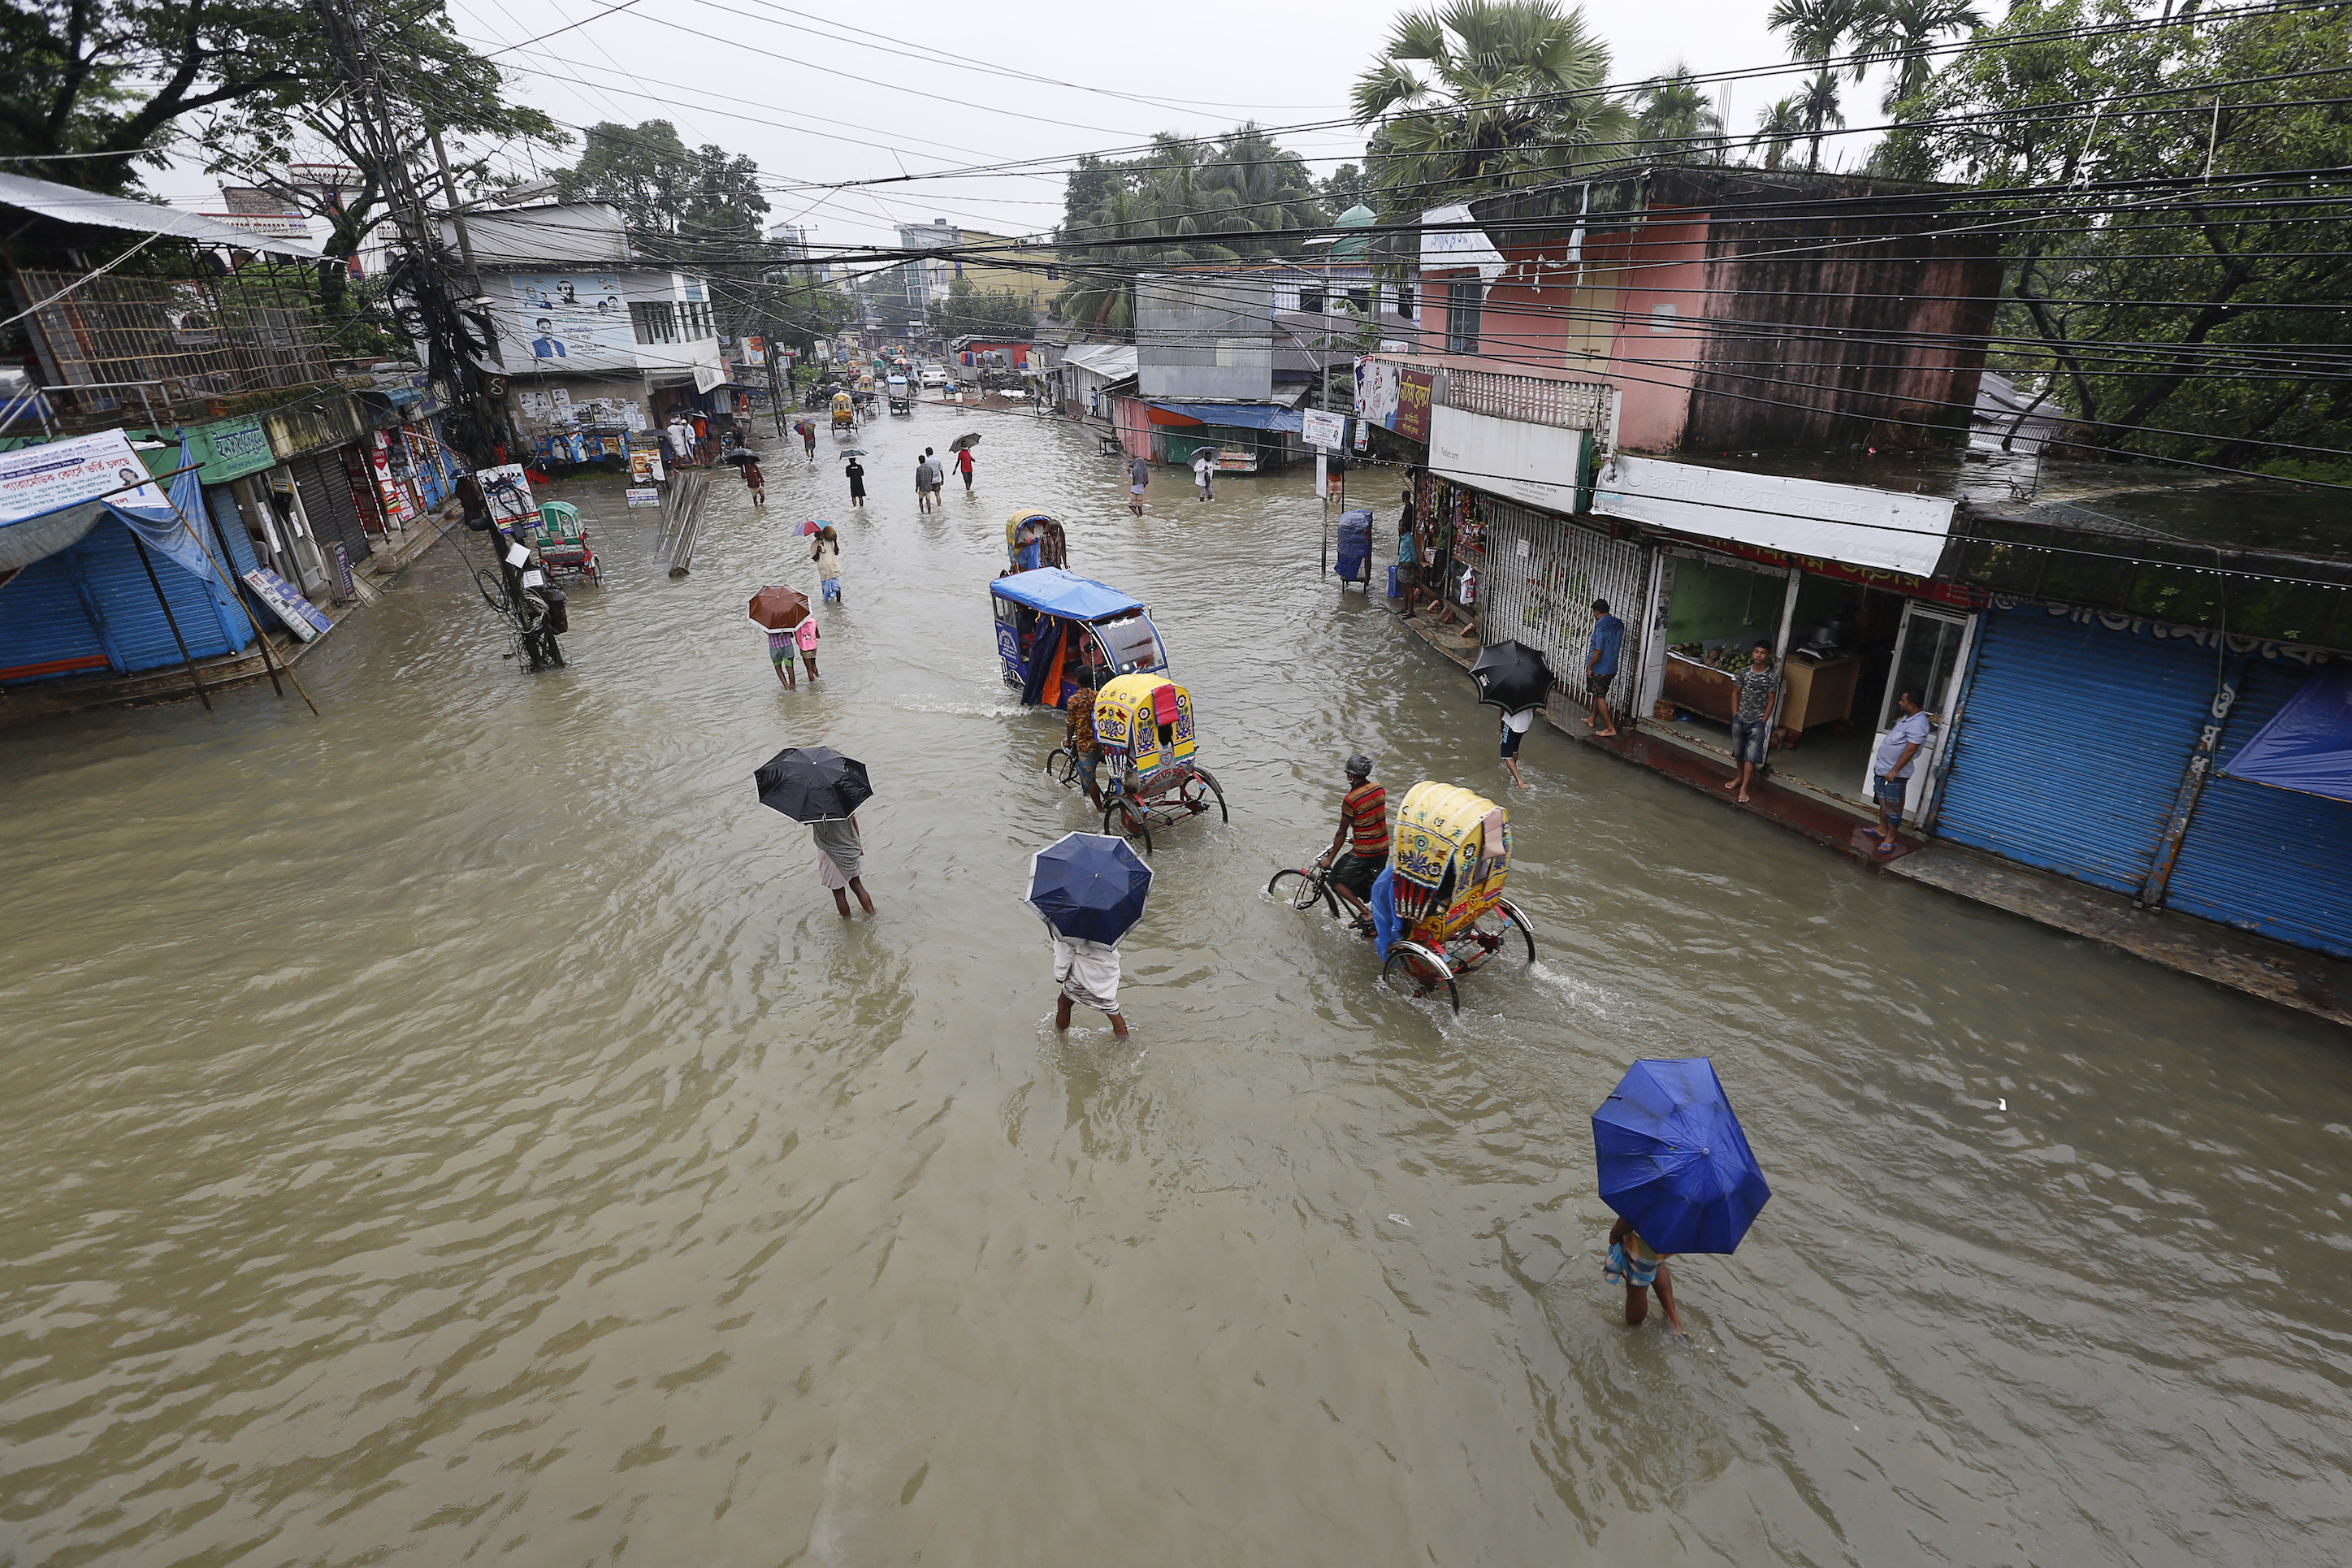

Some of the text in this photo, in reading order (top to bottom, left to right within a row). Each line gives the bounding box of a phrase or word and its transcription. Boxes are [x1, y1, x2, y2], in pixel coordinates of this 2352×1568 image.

[1441, 447, 1459, 460] Telecom
[2, 457, 133, 492] প্যারামেডিক কোর্সে ভর্তি চলছে
[1107, 617, 1137, 630] POWER
